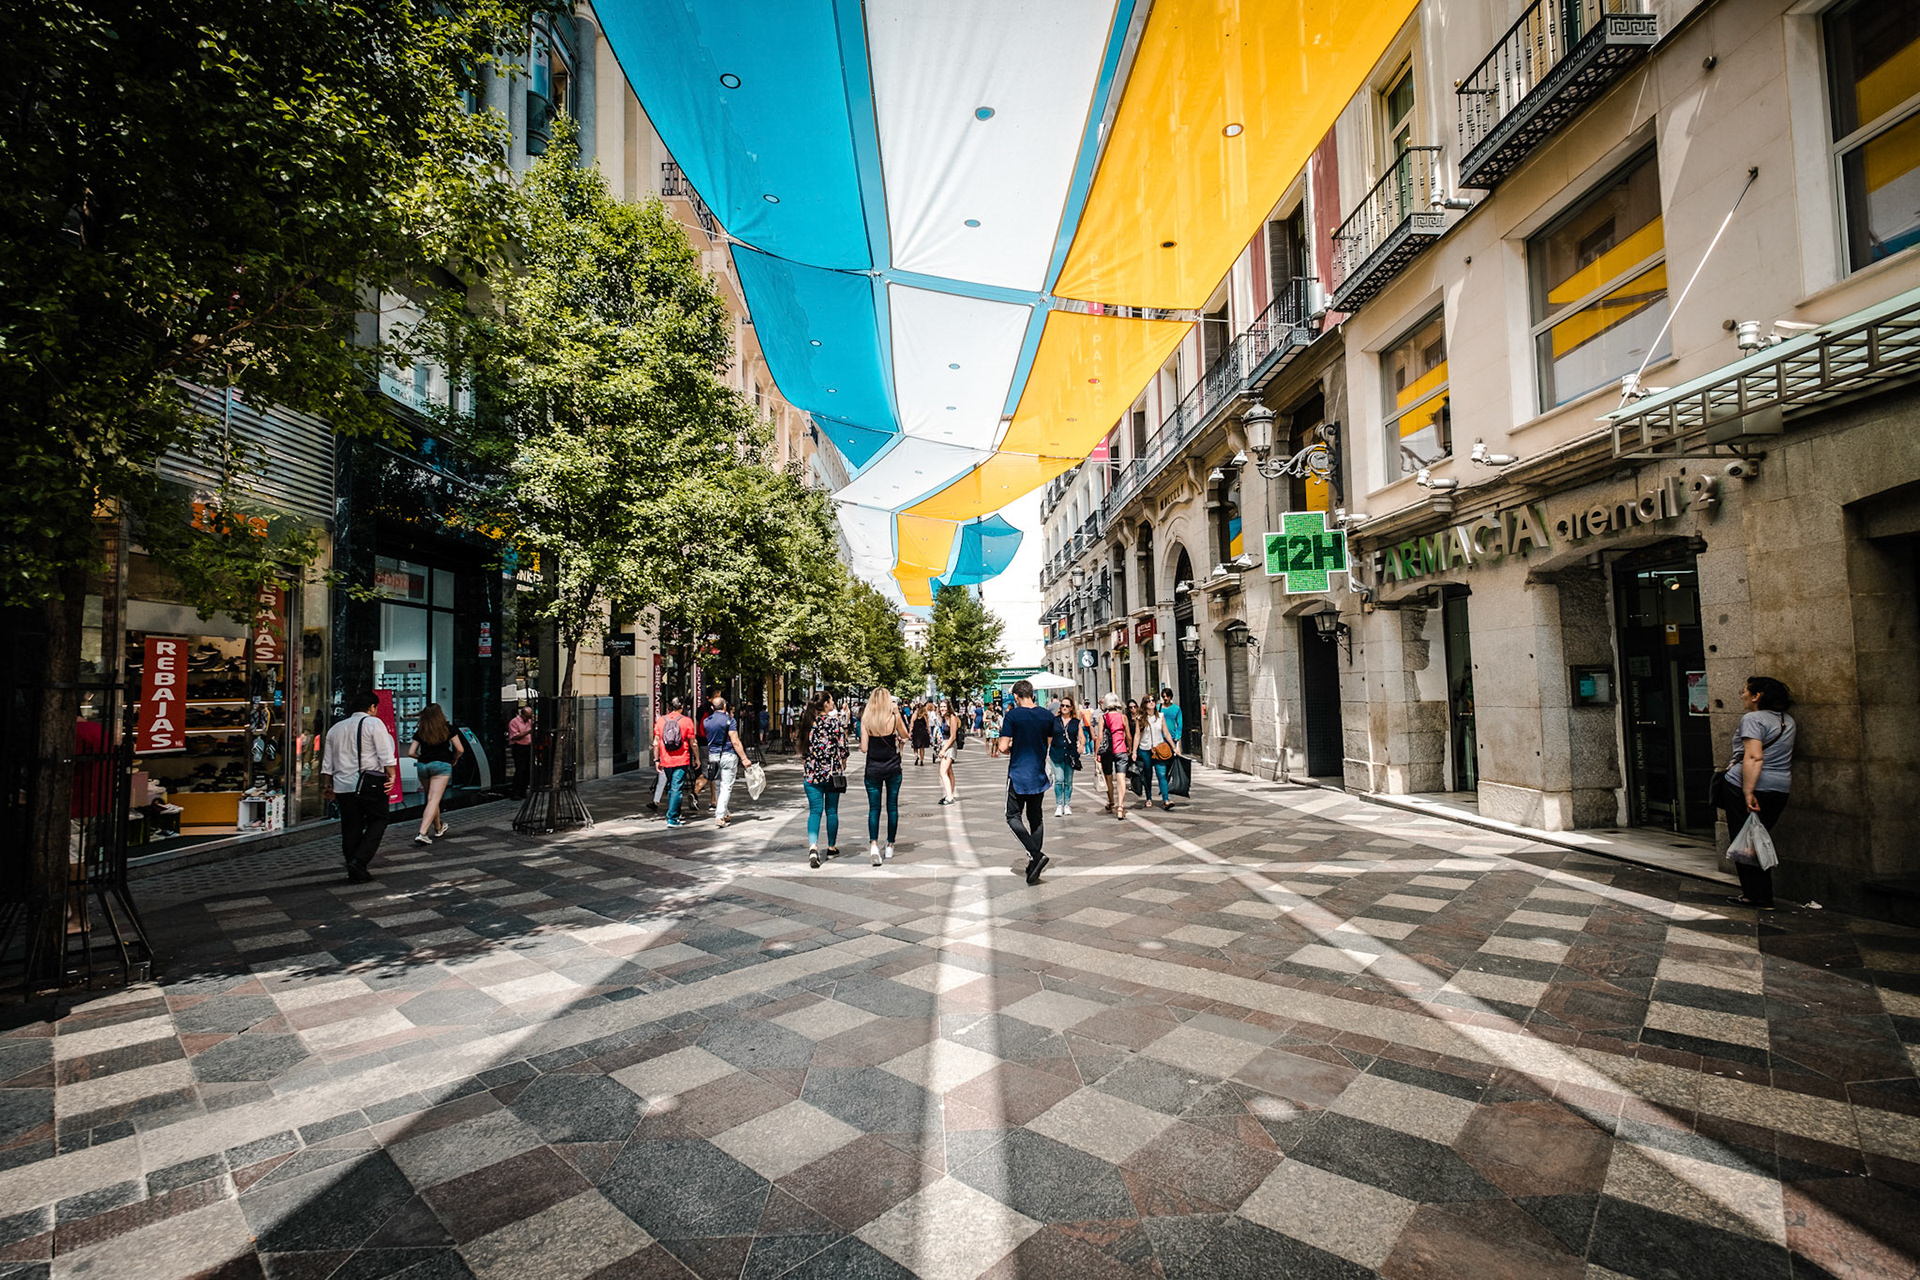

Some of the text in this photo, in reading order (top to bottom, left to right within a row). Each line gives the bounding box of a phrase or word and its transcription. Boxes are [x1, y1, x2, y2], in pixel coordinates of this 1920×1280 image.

[1371, 505, 1550, 587] FARMACIA
[1553, 474, 1718, 542] arenal 2
[1267, 533, 1344, 571] 12H
[254, 577, 276, 659] EBAJAS
[149, 641, 177, 748] REBAJAS
